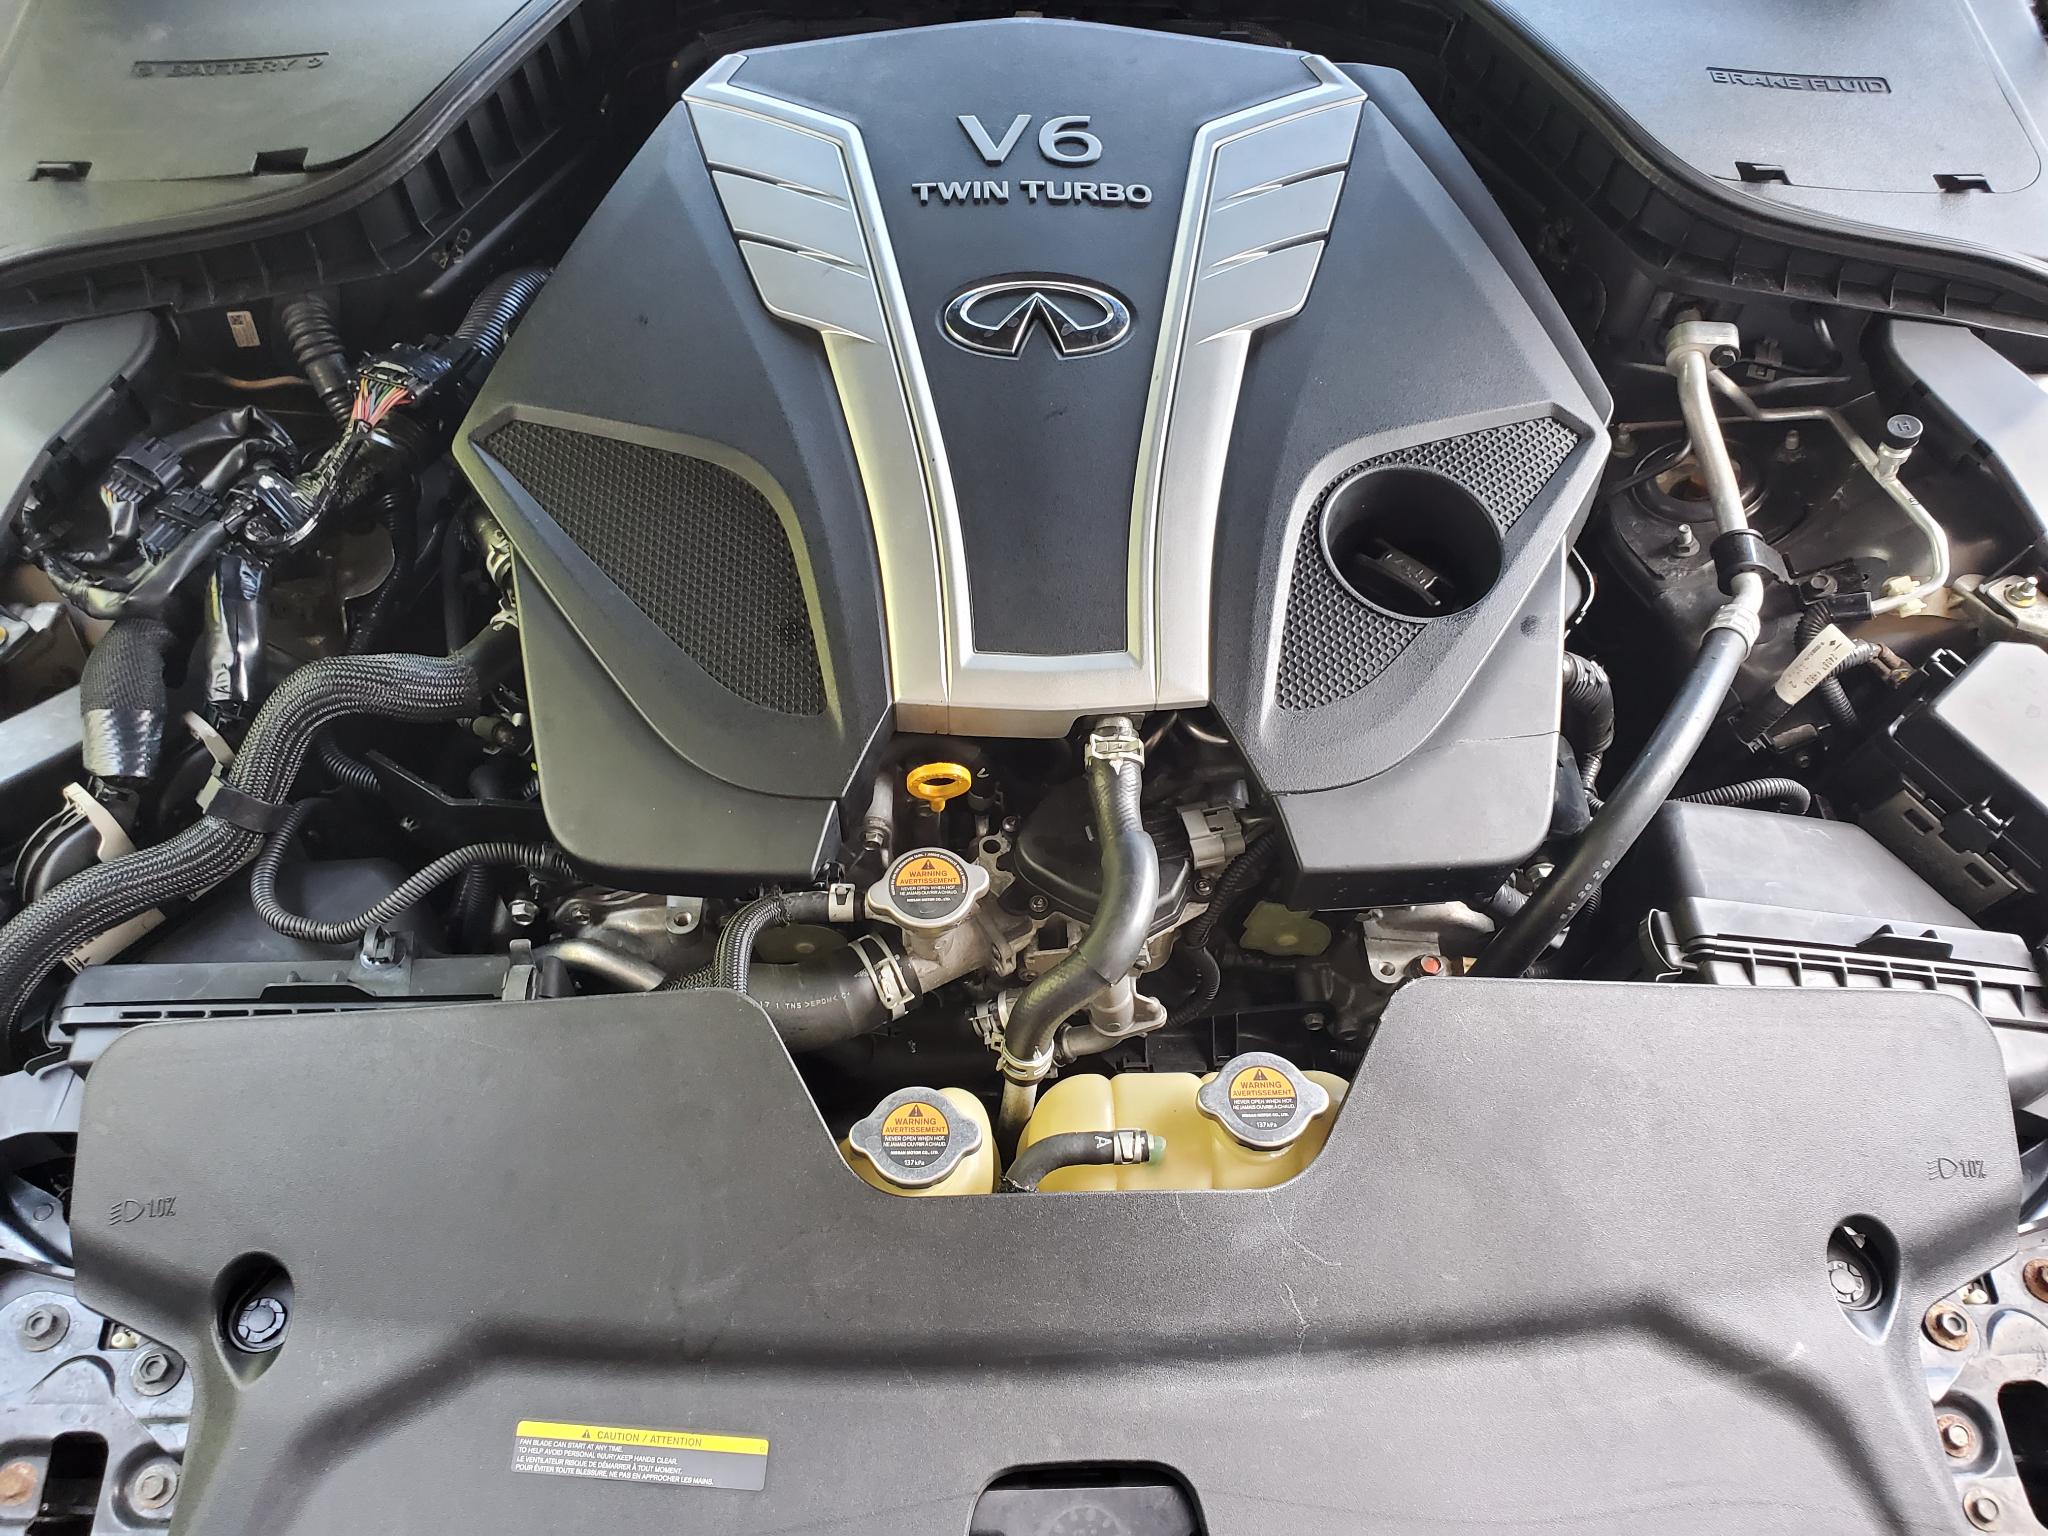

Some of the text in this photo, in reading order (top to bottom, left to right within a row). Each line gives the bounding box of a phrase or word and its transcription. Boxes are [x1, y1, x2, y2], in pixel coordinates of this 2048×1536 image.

[1708, 70, 1885, 93] BRAKE FLUID
[956, 114, 1103, 168] V6
[911, 180, 1153, 208] TWIN TURBO
[900, 877, 957, 885] AVERTISSEMENT
[533, 1439, 553, 1447] BLADE
[567, 1441, 586, 1449] START
[595, 1443, 608, 1451] ANY
[597, 1430, 640, 1442] CAUTION
[650, 1435, 702, 1447] ATTENTION
[525, 1456, 564, 1465] VENTILATEUR
[565, 1459, 587, 1468] RISQUE
[597, 1459, 631, 1471] DÉMARRER
[544, 1448, 563, 1456] AVOID
[564, 1450, 595, 1459] PERSONAL
[634, 1455, 655, 1463] HANDS
[515, 1463, 533, 1471] POUR
[555, 1466, 574, 1474] TOUTE
[618, 1471, 631, 1479] PAS
[632, 1472, 641, 1480] EN
[641, 1474, 680, 1483] APPROCHER
[680, 1476, 692, 1484] LES
